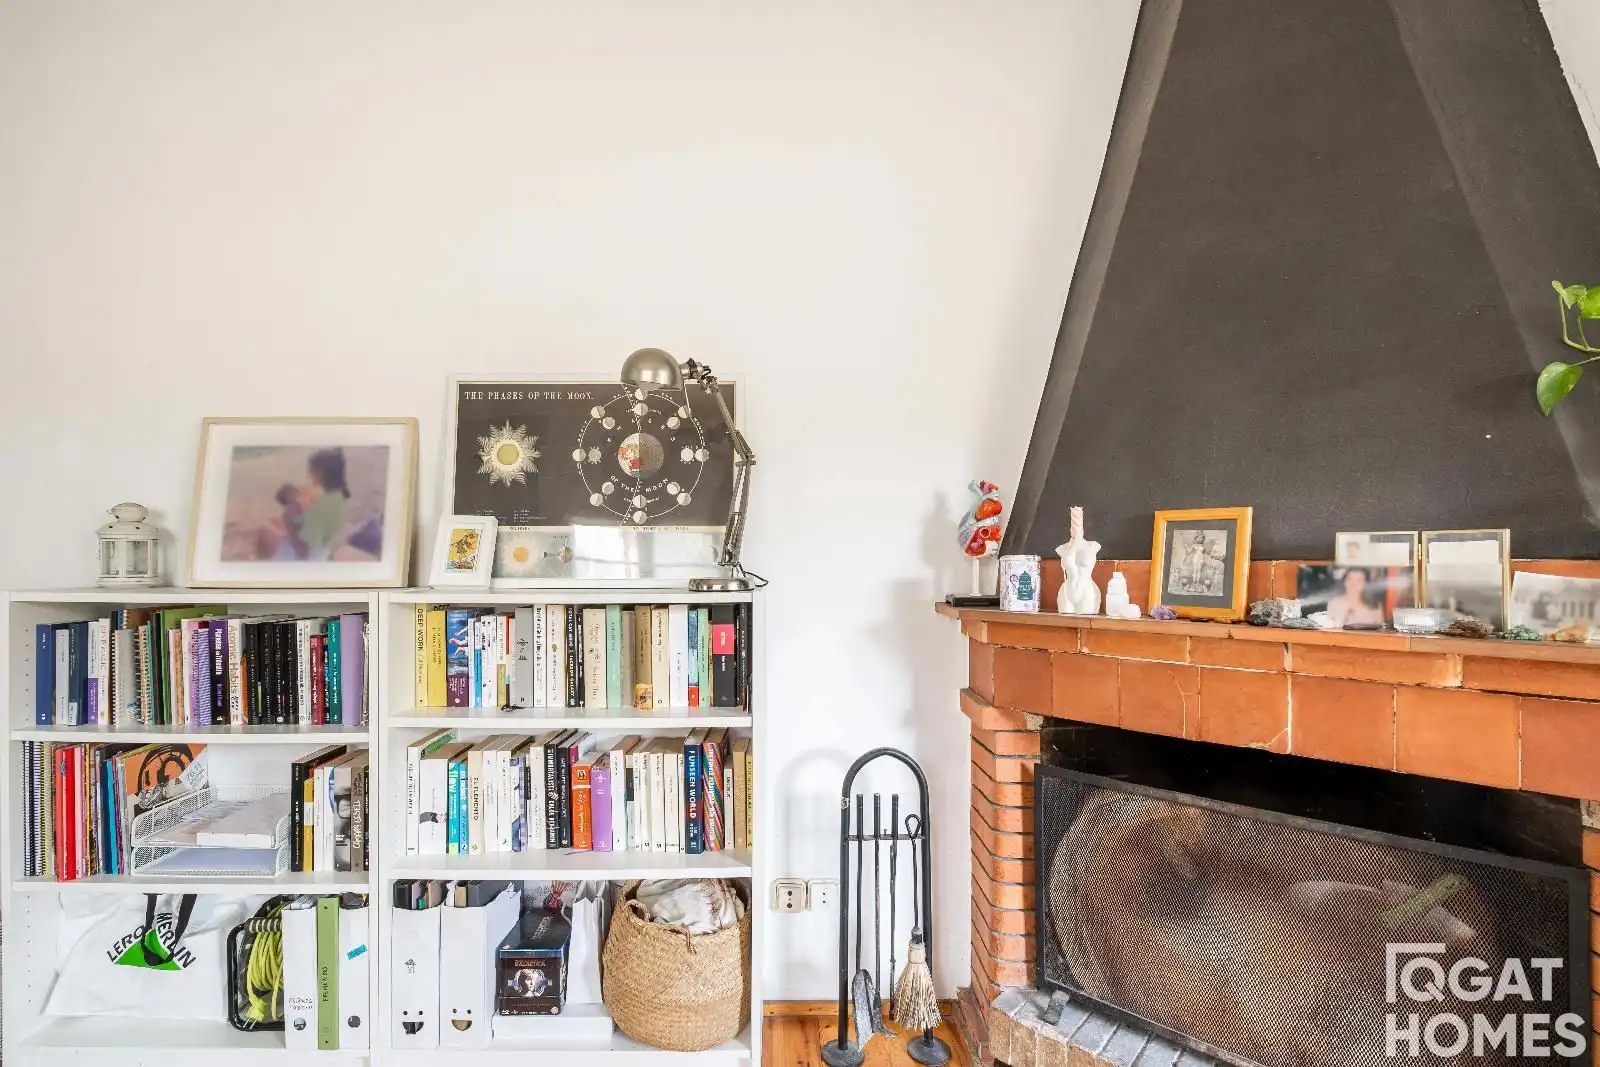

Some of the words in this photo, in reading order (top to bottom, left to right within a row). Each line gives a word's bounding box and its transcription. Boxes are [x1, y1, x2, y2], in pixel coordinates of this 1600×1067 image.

[464, 391, 483, 400] THE
[488, 391, 524, 400] PHASES
[527, 391, 539, 400] OF
[544, 391, 562, 400] THE
[229, 624, 238, 660] Atomic
[230, 662, 239, 694] Habits
[449, 770, 459, 792] flow
[688, 755, 696, 787] UNSEEN
[689, 788, 697, 819] WORLD
[106, 924, 148, 963] LERO
